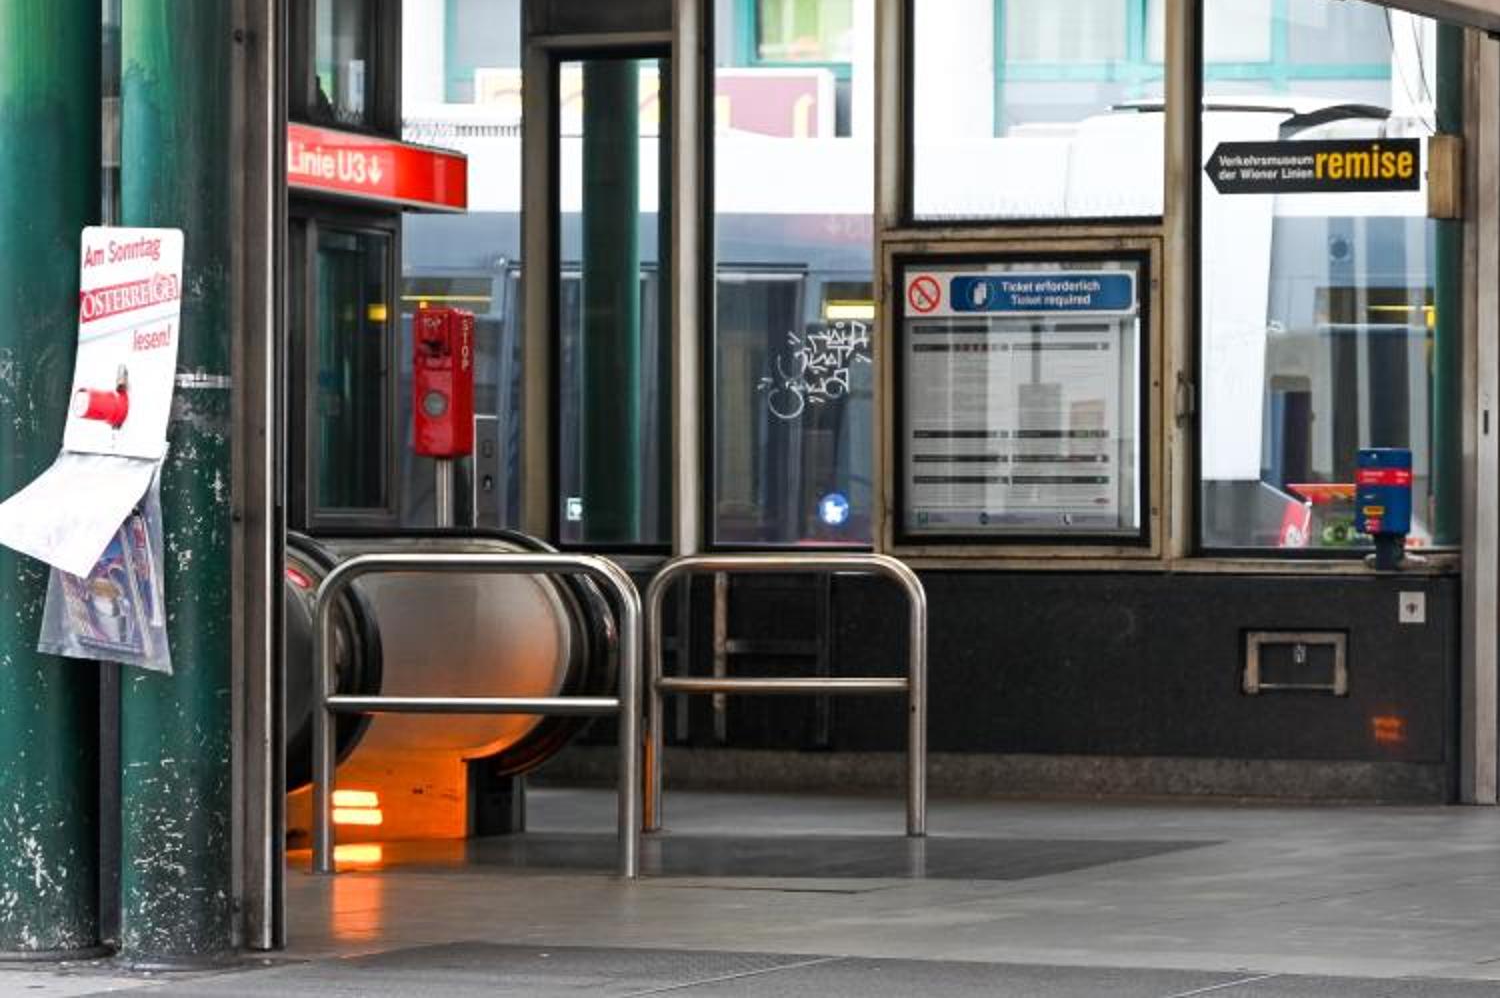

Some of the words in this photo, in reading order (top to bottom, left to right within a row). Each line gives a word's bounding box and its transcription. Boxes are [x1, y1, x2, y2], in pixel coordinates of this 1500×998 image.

[288, 140, 335, 180] Linie
[337, 148, 366, 184] U3
[1218, 154, 1315, 168] Verkehrsmuseum
[1315, 143, 1414, 180] remise
[1218, 168, 1237, 180] der
[1240, 168, 1278, 180] Wiener
[1281, 167, 1314, 180] Linien
[84, 244, 105, 269] Am
[107, 235, 162, 264] Sonntag
[1001, 280, 1033, 293] Ticket
[132, 323, 172, 352] lesen!
